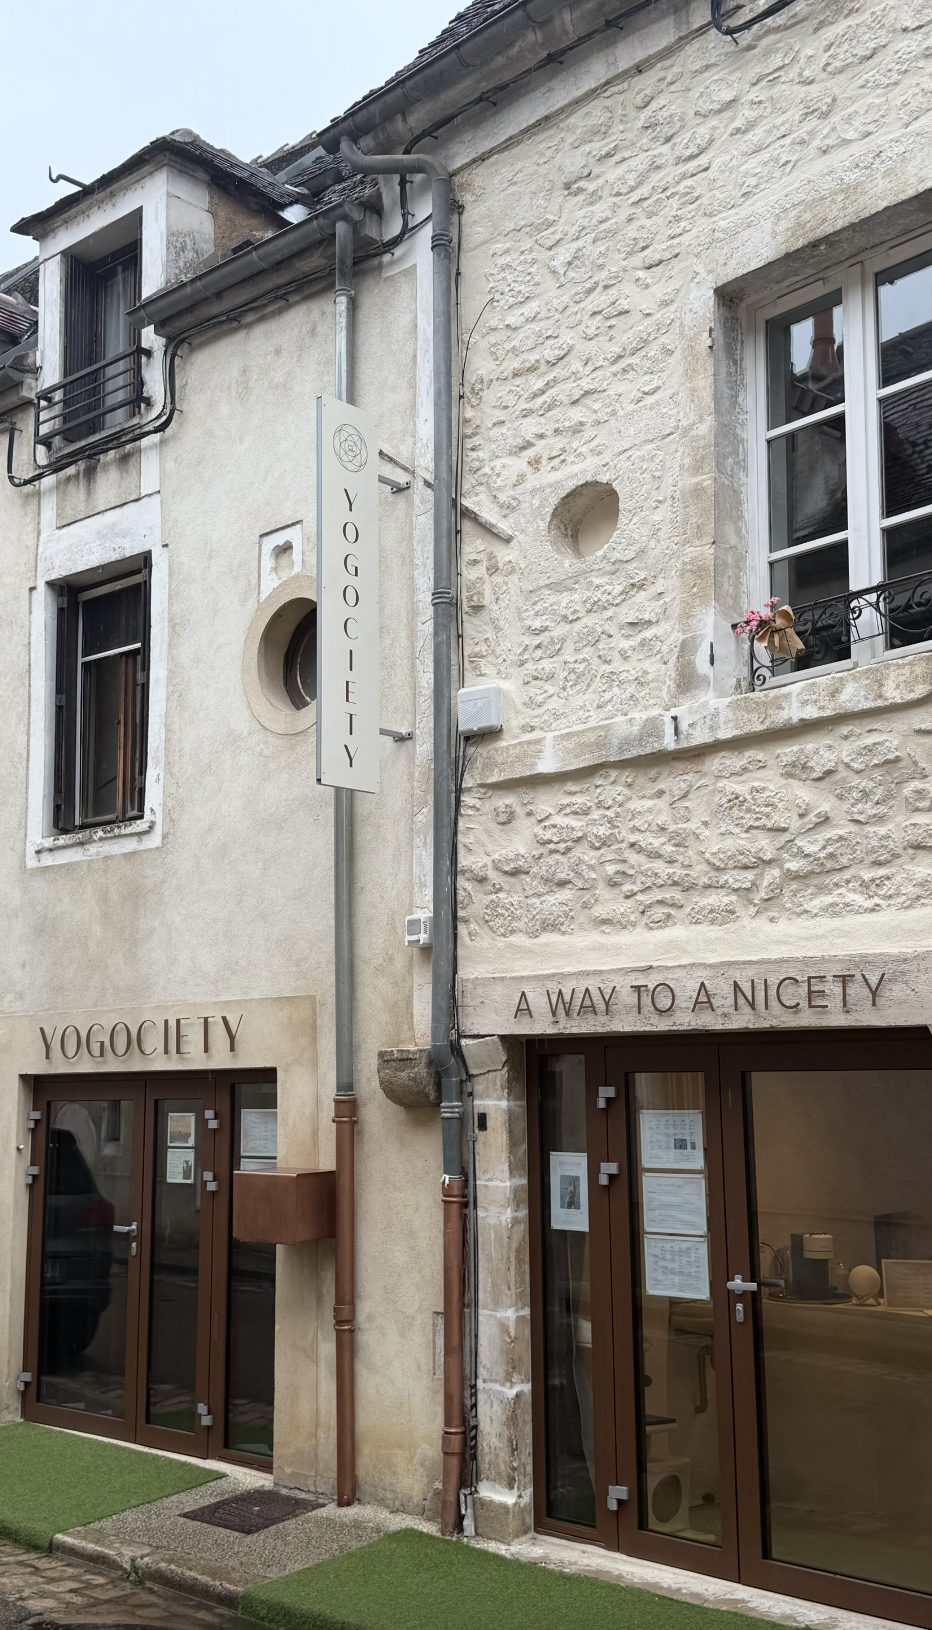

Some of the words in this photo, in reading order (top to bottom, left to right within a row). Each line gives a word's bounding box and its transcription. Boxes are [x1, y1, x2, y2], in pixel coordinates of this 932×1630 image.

[342, 488, 359, 767] YOGOCIETY
[513, 990, 533, 1019] A
[546, 985, 617, 1018] WAY
[630, 982, 676, 1014] TO
[691, 981, 715, 1013] A
[733, 973, 886, 1012] NICETY
[39, 1014, 243, 1060] YOGOCIETY
